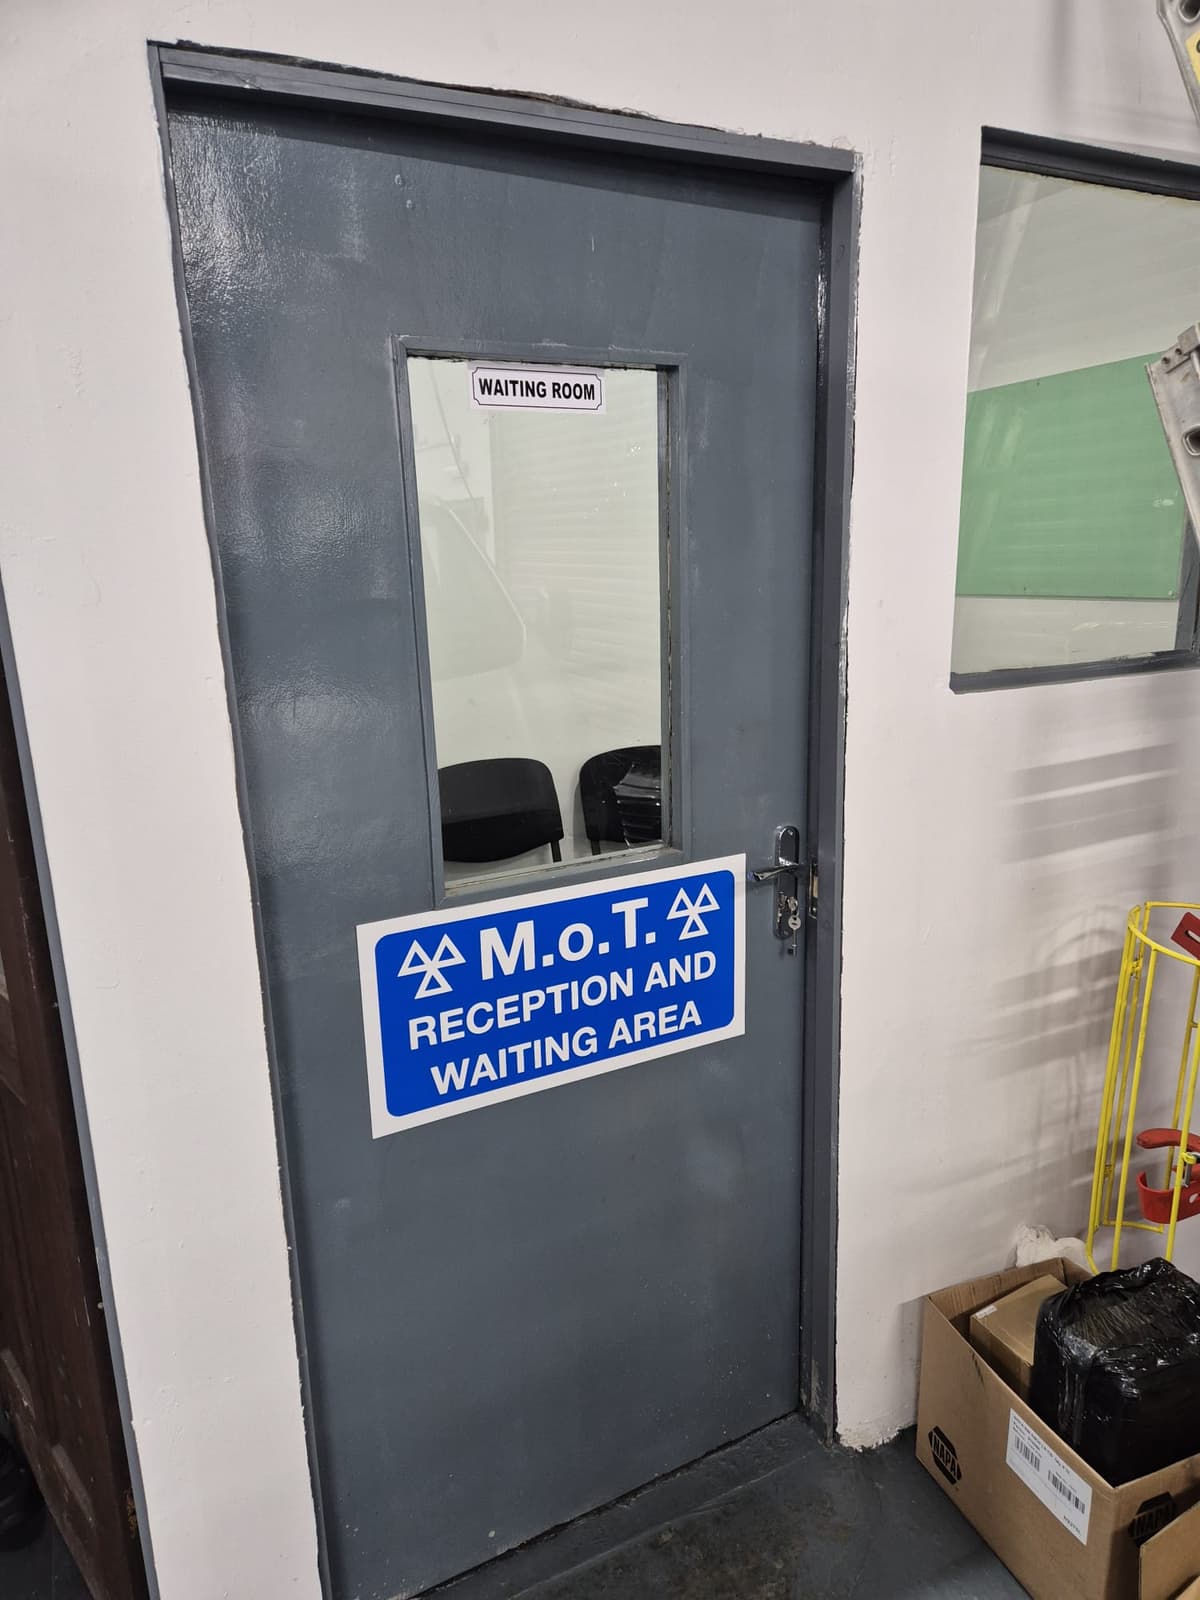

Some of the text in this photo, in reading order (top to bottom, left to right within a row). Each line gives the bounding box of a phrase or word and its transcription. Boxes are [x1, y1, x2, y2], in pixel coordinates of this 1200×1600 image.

[478, 378, 595, 401] WAITING ROOM
[479, 898, 656, 981] M.o.T.
[408, 950, 717, 1050] RECEPTION AND
[430, 1000, 702, 1095] WAITING AREA
[931, 1431, 959, 1481] NAPA
